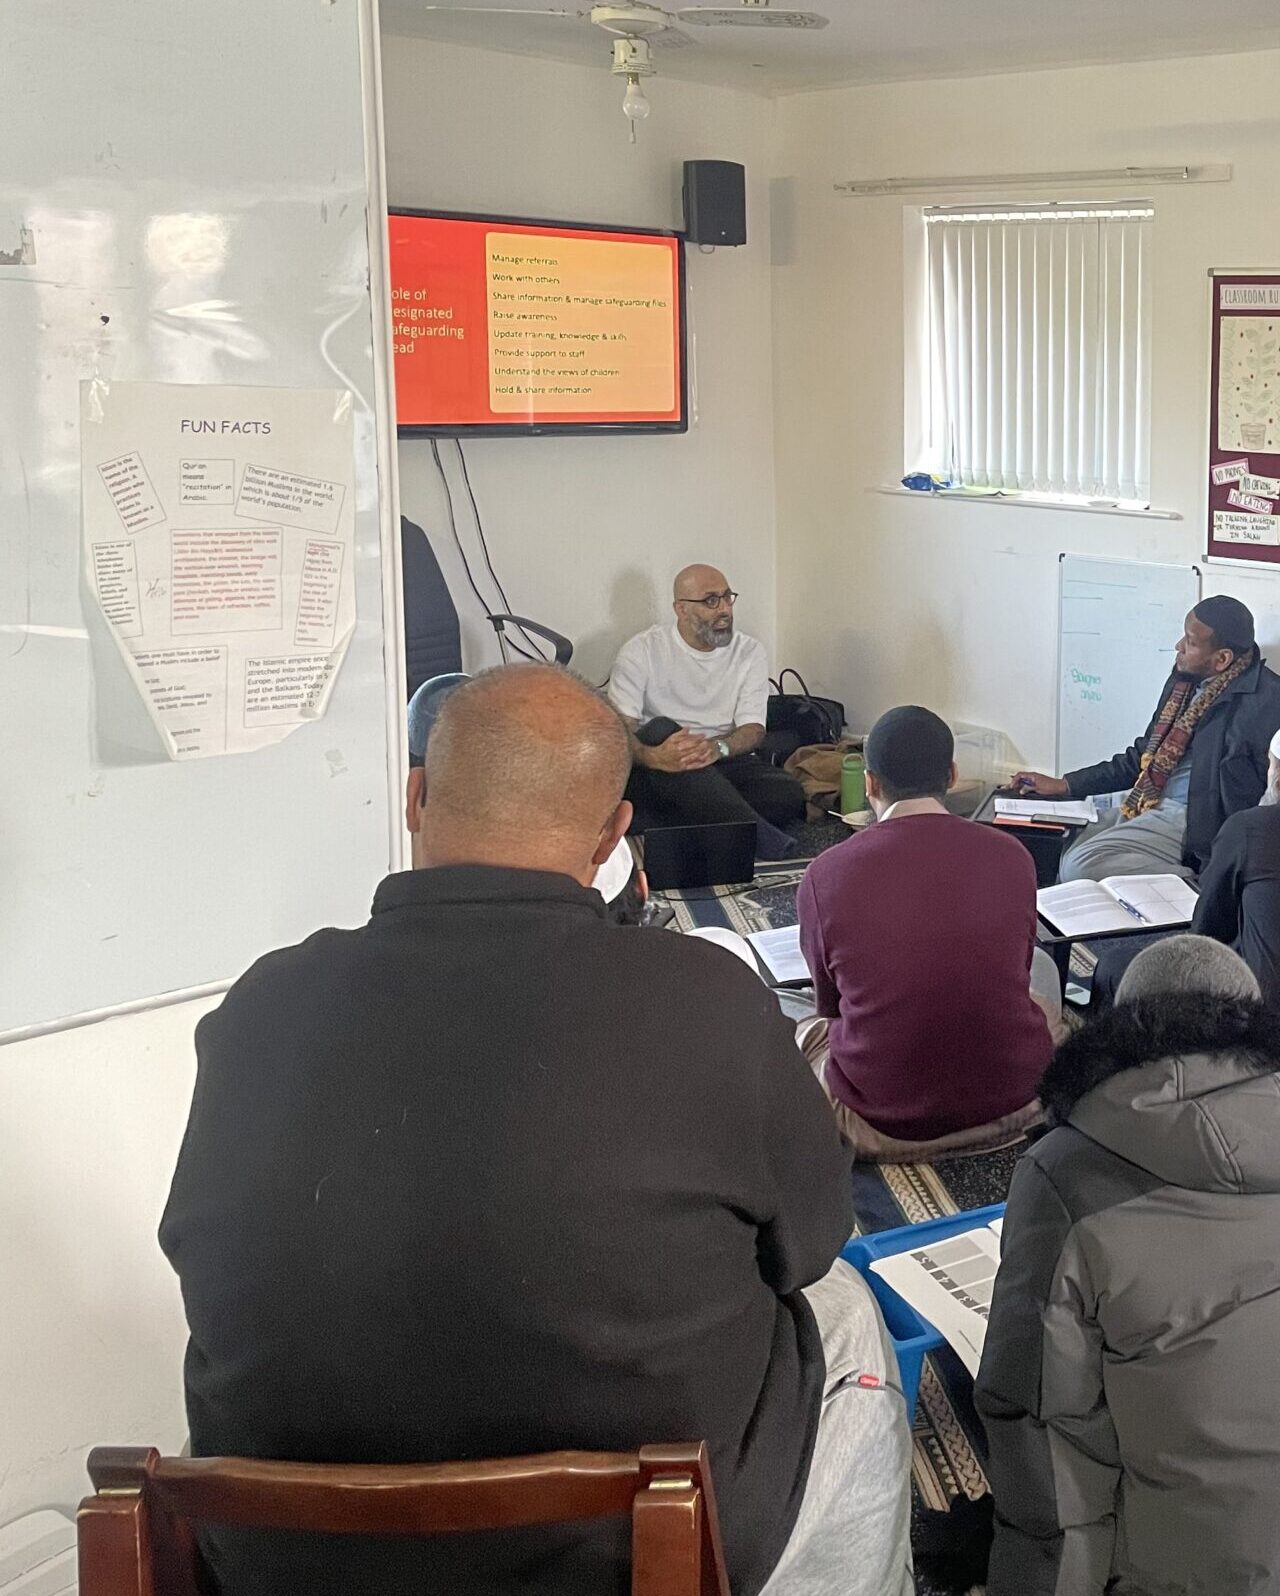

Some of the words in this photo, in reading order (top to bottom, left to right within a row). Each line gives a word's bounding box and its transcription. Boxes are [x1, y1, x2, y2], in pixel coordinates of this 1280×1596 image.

[493, 253, 524, 265] Manage
[493, 273, 513, 281] Work
[516, 274, 533, 282] with
[536, 276, 560, 284] others
[391, 287, 410, 300] ole
[414, 287, 427, 300] of
[493, 292, 514, 301] Share
[518, 294, 562, 303] information
[566, 295, 571, 303] &
[574, 297, 603, 305] manage
[1225, 289, 1266, 304] CLASSROOM
[393, 307, 453, 320] esignated
[493, 310, 514, 319] Raise
[517, 313, 558, 321] awareness
[392, 324, 464, 339] afeguarding
[494, 330, 522, 340] Update
[559, 333, 600, 341] knowledge
[602, 333, 608, 341] &
[392, 341, 415, 354] ead
[494, 349, 524, 357] Provide
[526, 350, 556, 358] support
[559, 350, 566, 358] to
[569, 350, 585, 358] staff
[495, 367, 541, 376] Understand
[543, 368, 556, 376] the
[581, 368, 589, 376] of
[590, 368, 620, 376] children
[548, 386, 592, 394] information
[181, 419, 216, 433] FUN
[221, 420, 271, 434] FACTS
[248, 466, 267, 476] There
[268, 471, 279, 479] are
[1215, 469, 1224, 482] NO
[1243, 477, 1250, 490] NO
[302, 488, 312, 496] the
[1232, 492, 1242, 503] NO
[1244, 495, 1270, 512] EATING
[1216, 514, 1223, 522] NO
[248, 687, 260, 695] and
